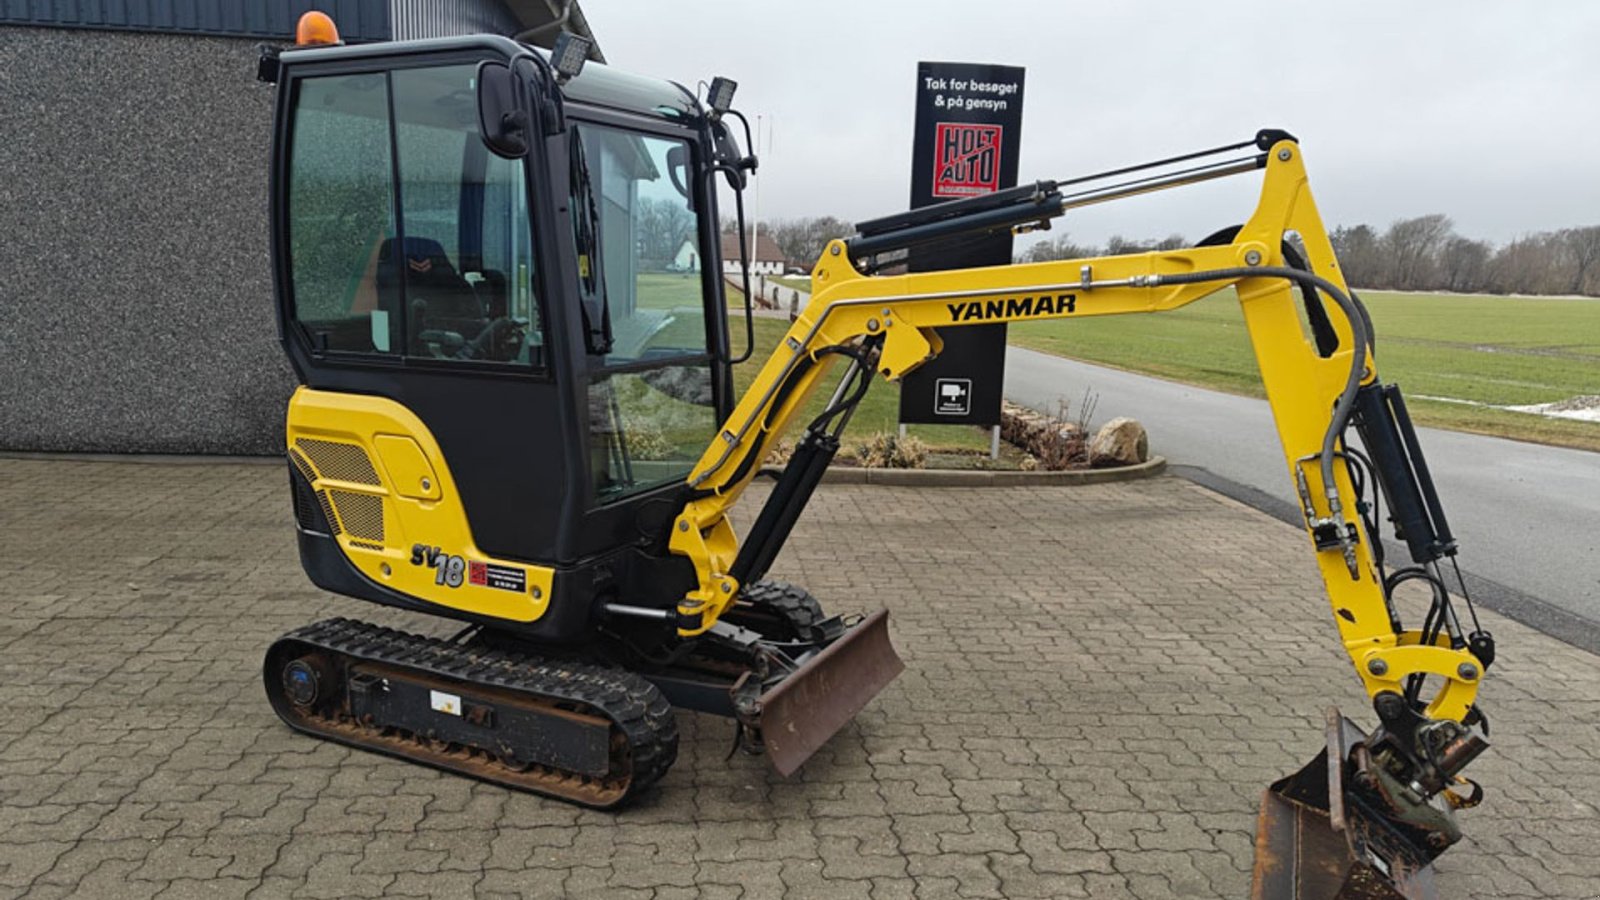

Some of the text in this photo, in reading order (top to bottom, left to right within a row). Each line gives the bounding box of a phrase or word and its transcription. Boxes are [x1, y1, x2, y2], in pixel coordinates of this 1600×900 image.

[925, 77, 1018, 96] Tak for besøget
[934, 94, 1007, 112] & på gensyn
[943, 127, 997, 165] HOLT
[940, 147, 995, 183] AUTO
[946, 294, 1076, 321] YANMAR
